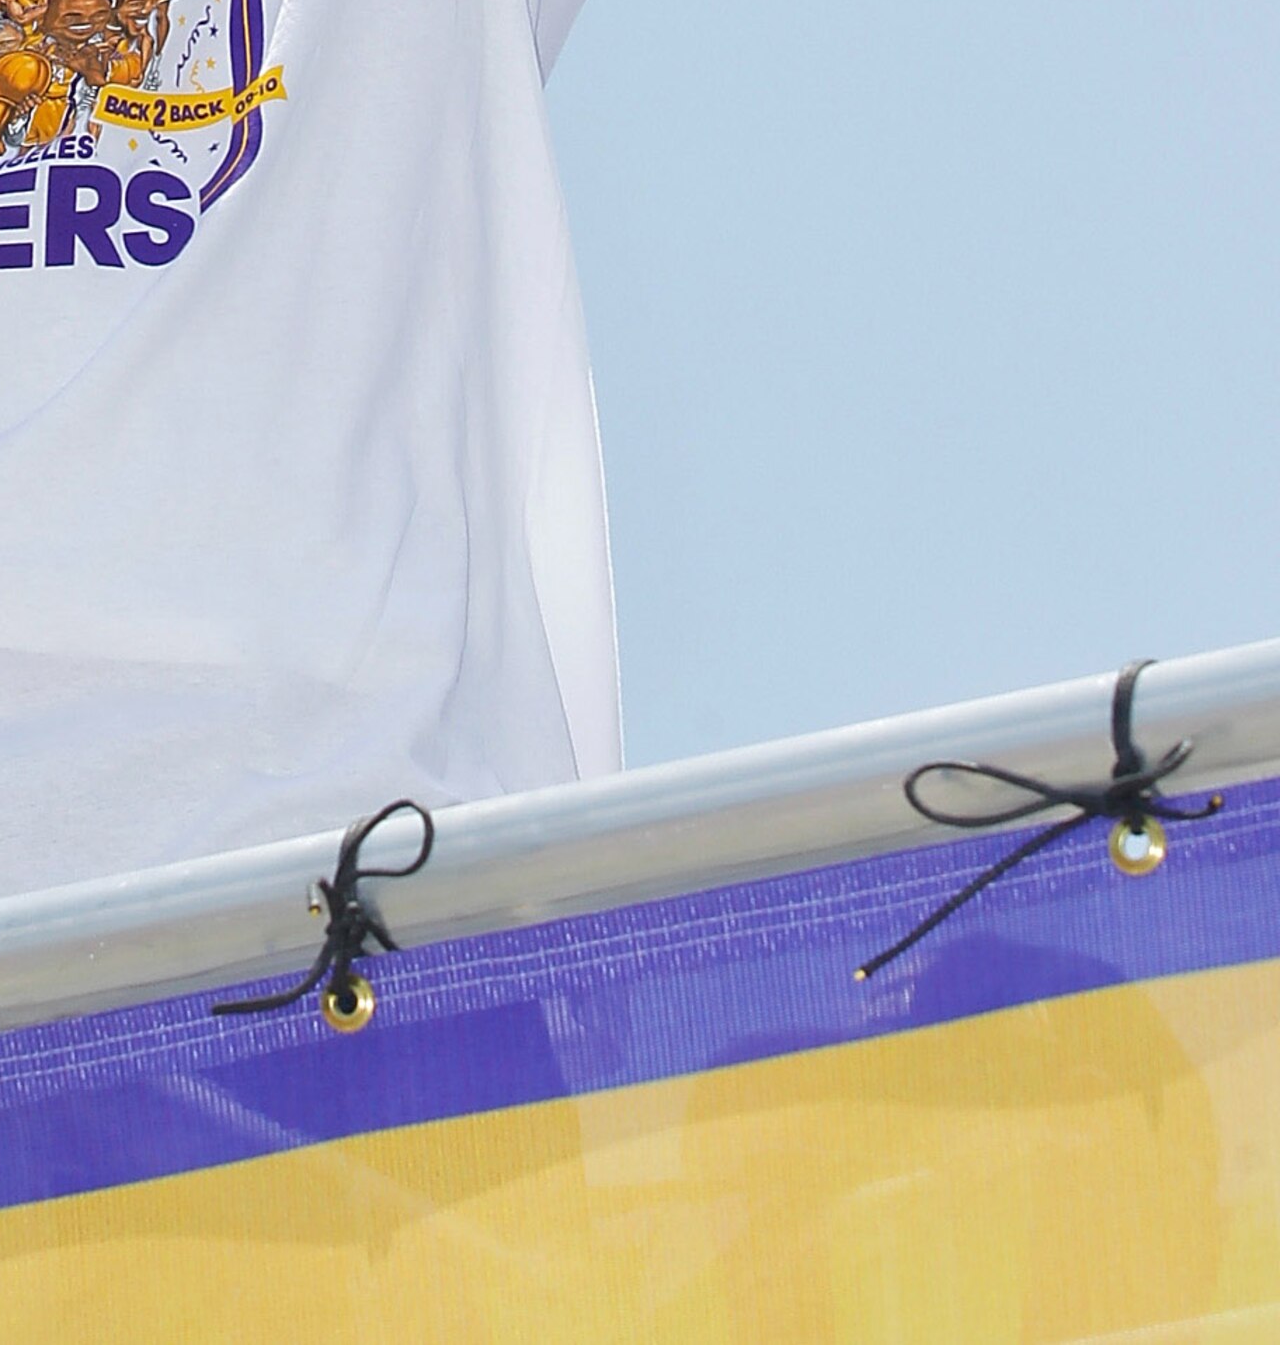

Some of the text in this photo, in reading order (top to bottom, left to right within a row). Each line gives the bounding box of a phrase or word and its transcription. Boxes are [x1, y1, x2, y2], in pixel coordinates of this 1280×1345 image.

[103, 94, 226, 127] BACK 2 BACK
[234, 76, 279, 115] 09-10
